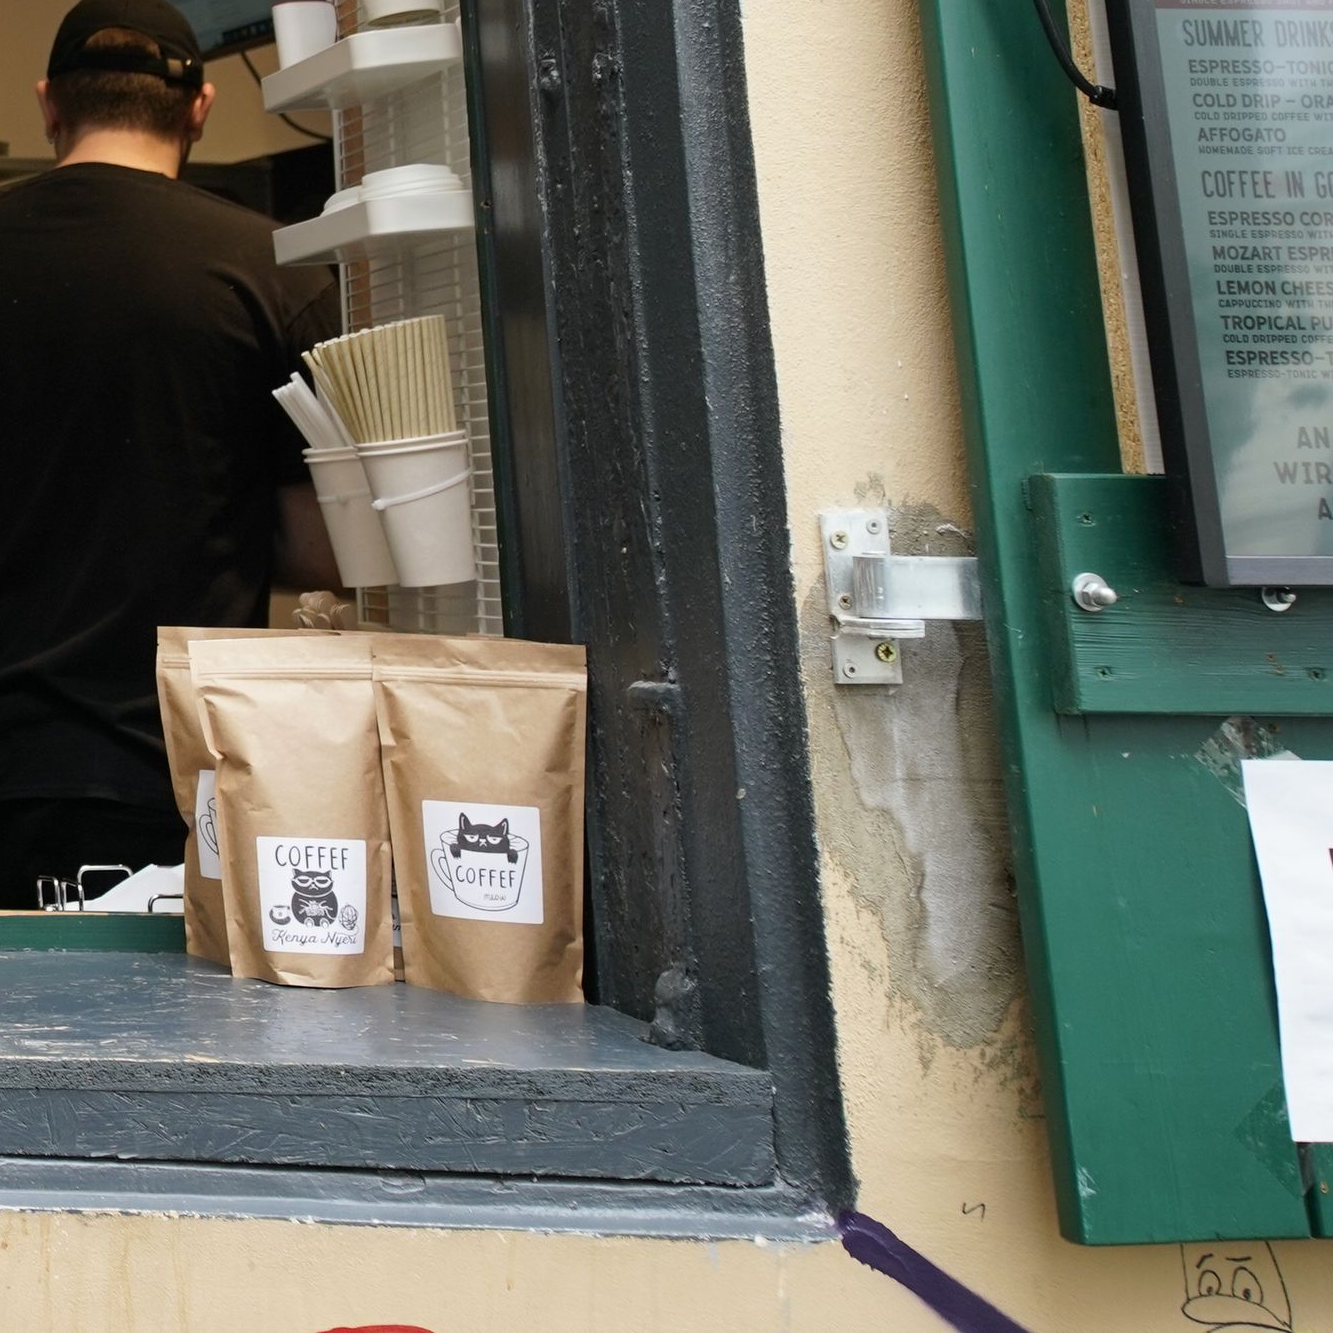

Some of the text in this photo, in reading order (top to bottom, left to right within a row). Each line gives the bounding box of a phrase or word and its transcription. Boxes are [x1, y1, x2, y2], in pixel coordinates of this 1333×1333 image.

[1181, 19, 1264, 47] SUMMER
[1190, 77, 1229, 87] DOUBLE
[1192, 93, 1238, 109] COLD
[1241, 94, 1281, 109] DRIP
[1194, 111, 1310, 123] COLD DRIPPED COFFEE
[1197, 126, 1287, 143] AFFOGATO
[1198, 146, 1304, 156] HOMEMADE SOFT ICE
[1200, 170, 1305, 200] COFFEE IN
[1207, 211, 1295, 226] ESPRESSO
[1209, 229, 1304, 239] SINGLE ESPRESSO
[1213, 245, 1333, 262] MOZART ESPR
[1214, 264, 1310, 274] DOUBLE ESPRESSO
[1216, 280, 1277, 296] LEMON
[1218, 298, 1314, 309] CAPPUCCINO WITH
[1220, 315, 1307, 331] TROPICAL
[1223, 334, 1250, 344] COLD
[1252, 334, 1298, 344] DRIPPED
[272, 928, 319, 946] Kenya
